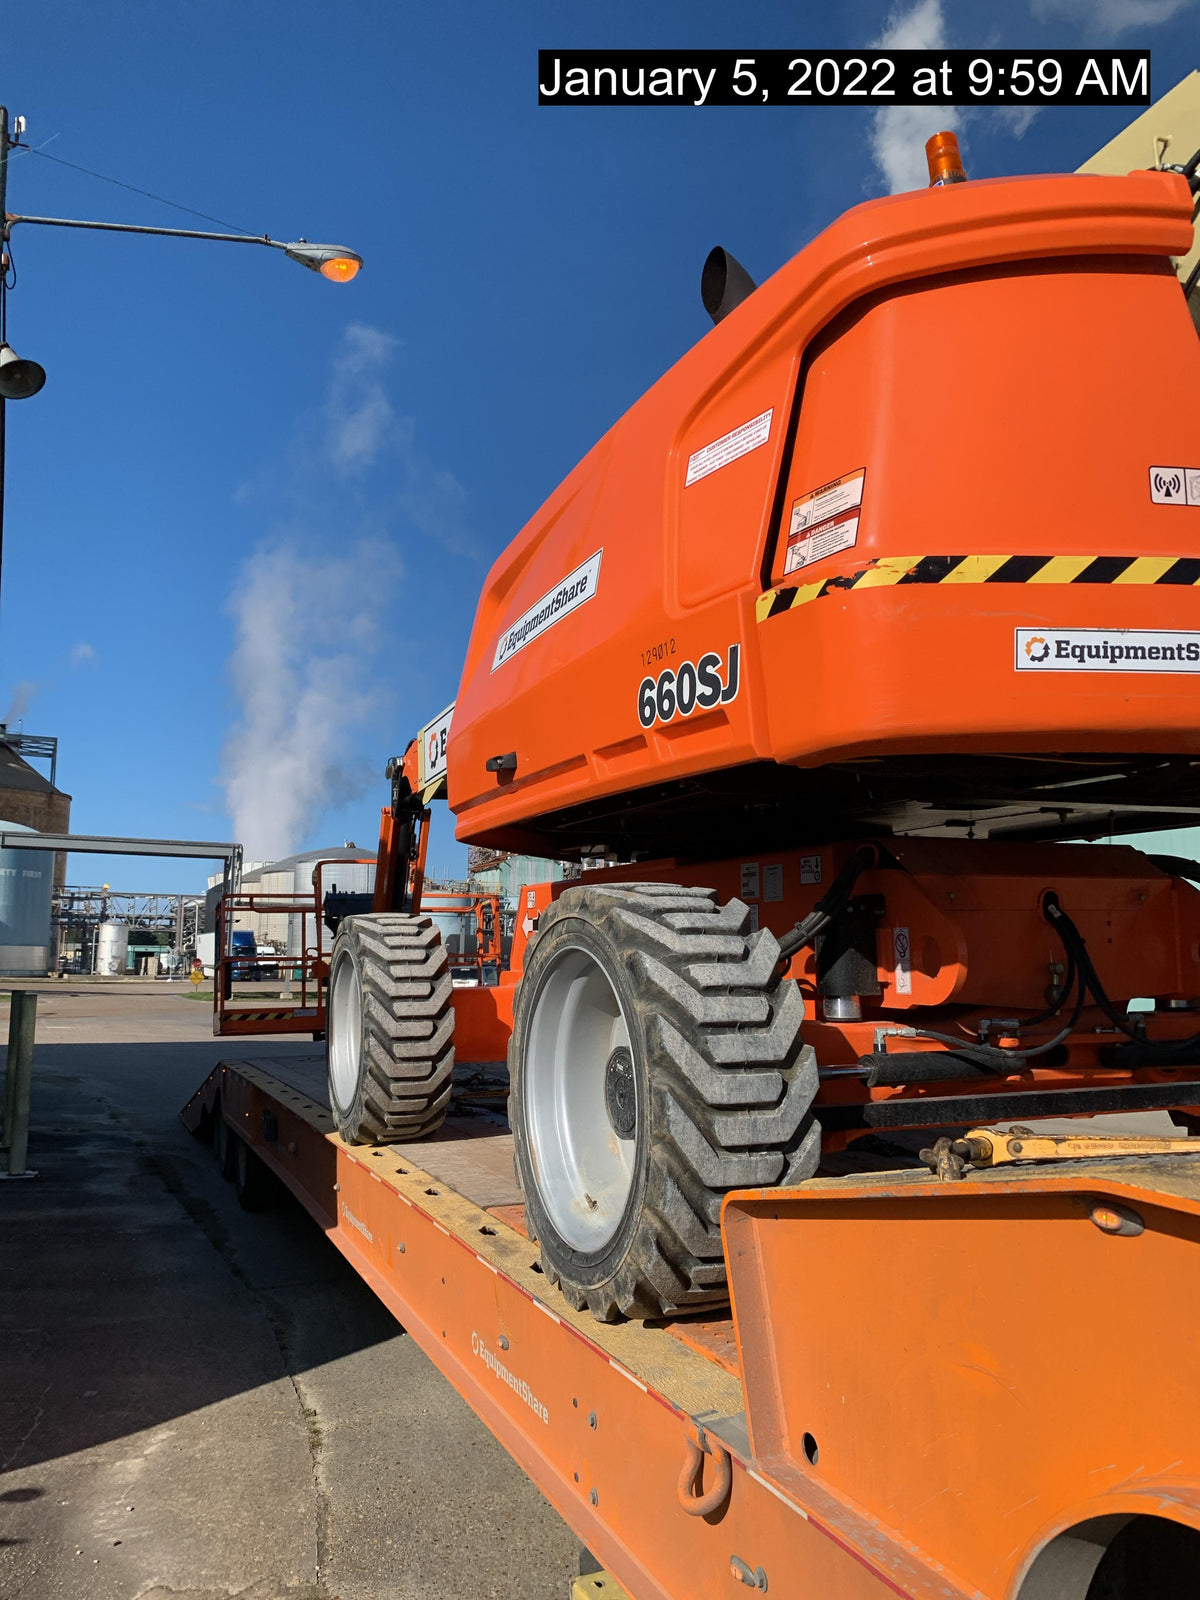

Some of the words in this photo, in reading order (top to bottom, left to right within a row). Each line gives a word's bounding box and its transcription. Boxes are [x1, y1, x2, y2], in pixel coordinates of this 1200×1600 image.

[731, 411, 772, 439] RESPONSIBILITY
[814, 480, 842, 497] WARNING
[810, 521, 835, 537] DANGER
[507, 575, 588, 651] EquipmentShare
[641, 638, 677, 667] 129012
[638, 643, 741, 729] 660SJ
[480, 1339, 549, 1425] EquipmentShare
